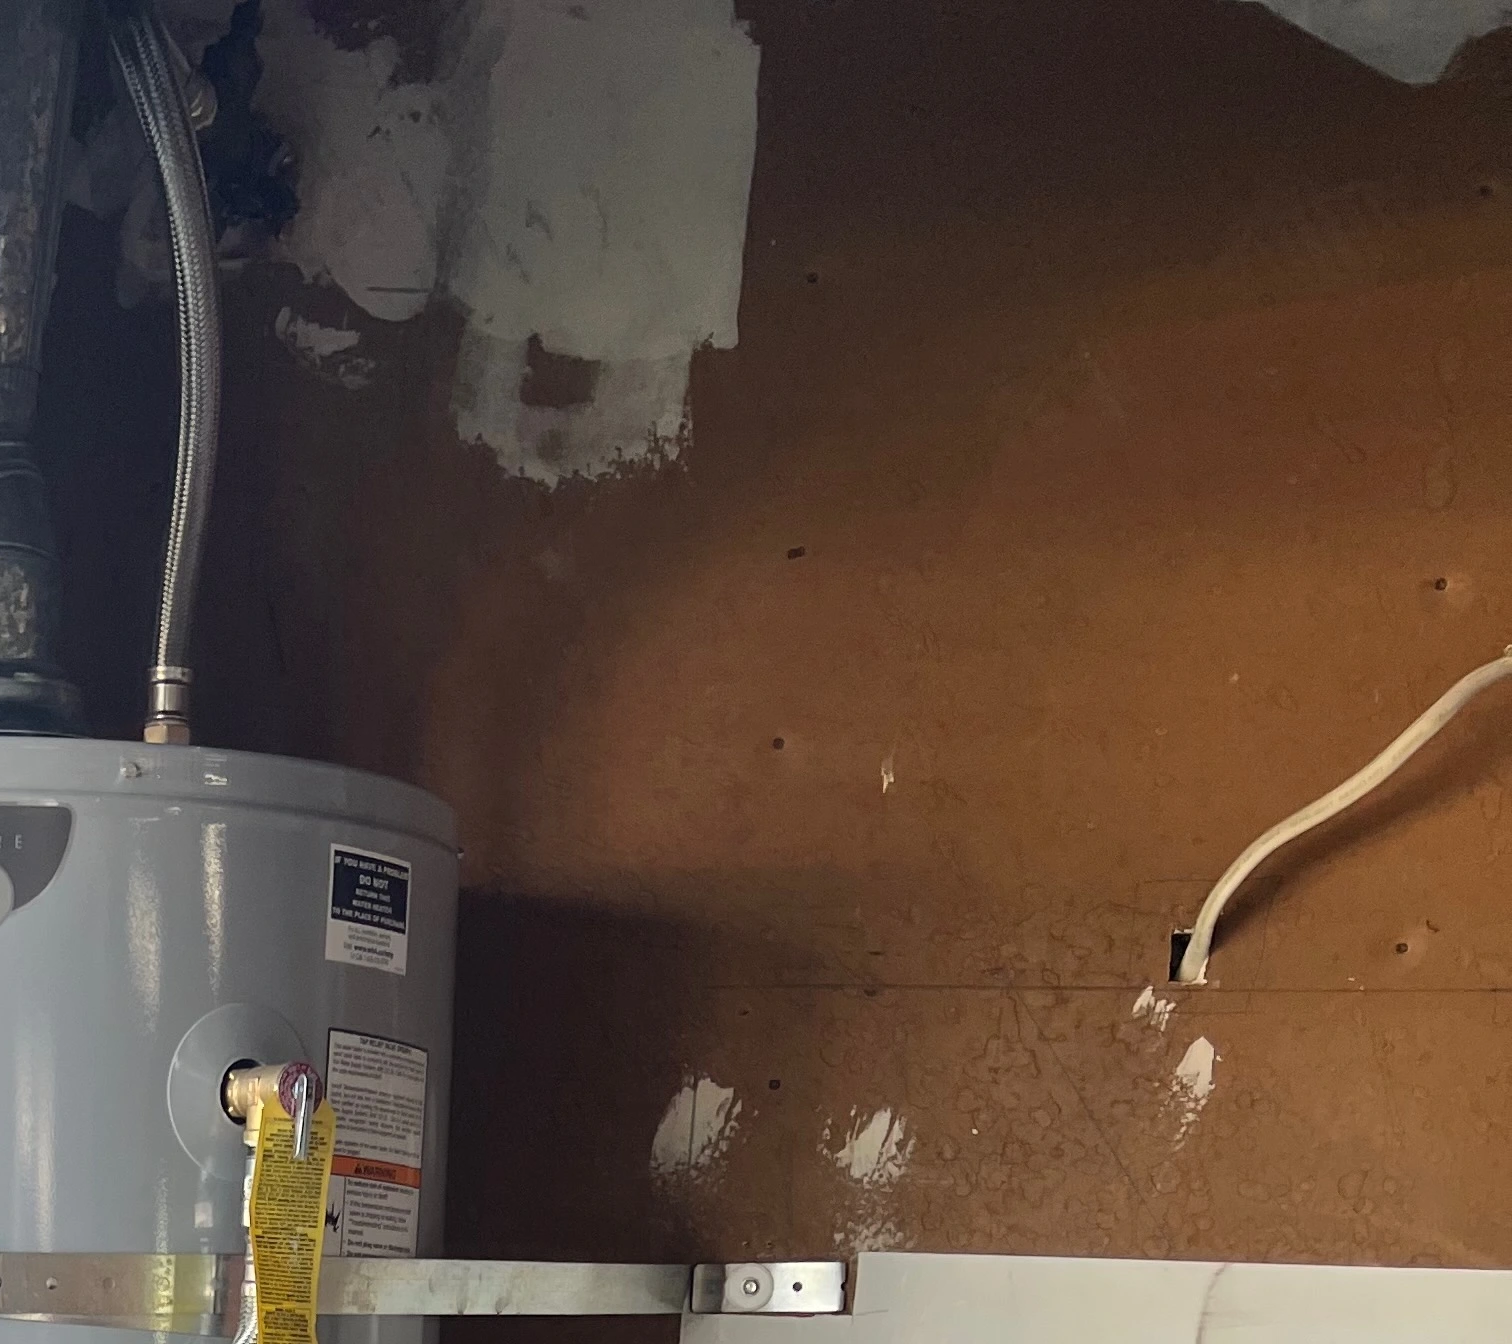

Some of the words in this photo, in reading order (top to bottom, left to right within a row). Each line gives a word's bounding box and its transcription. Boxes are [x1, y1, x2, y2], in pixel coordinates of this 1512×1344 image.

[344, 858, 358, 867] YOU
[359, 874, 371, 885] DO
[373, 877, 389, 890] NOT
[354, 911, 371, 921] PLACE
